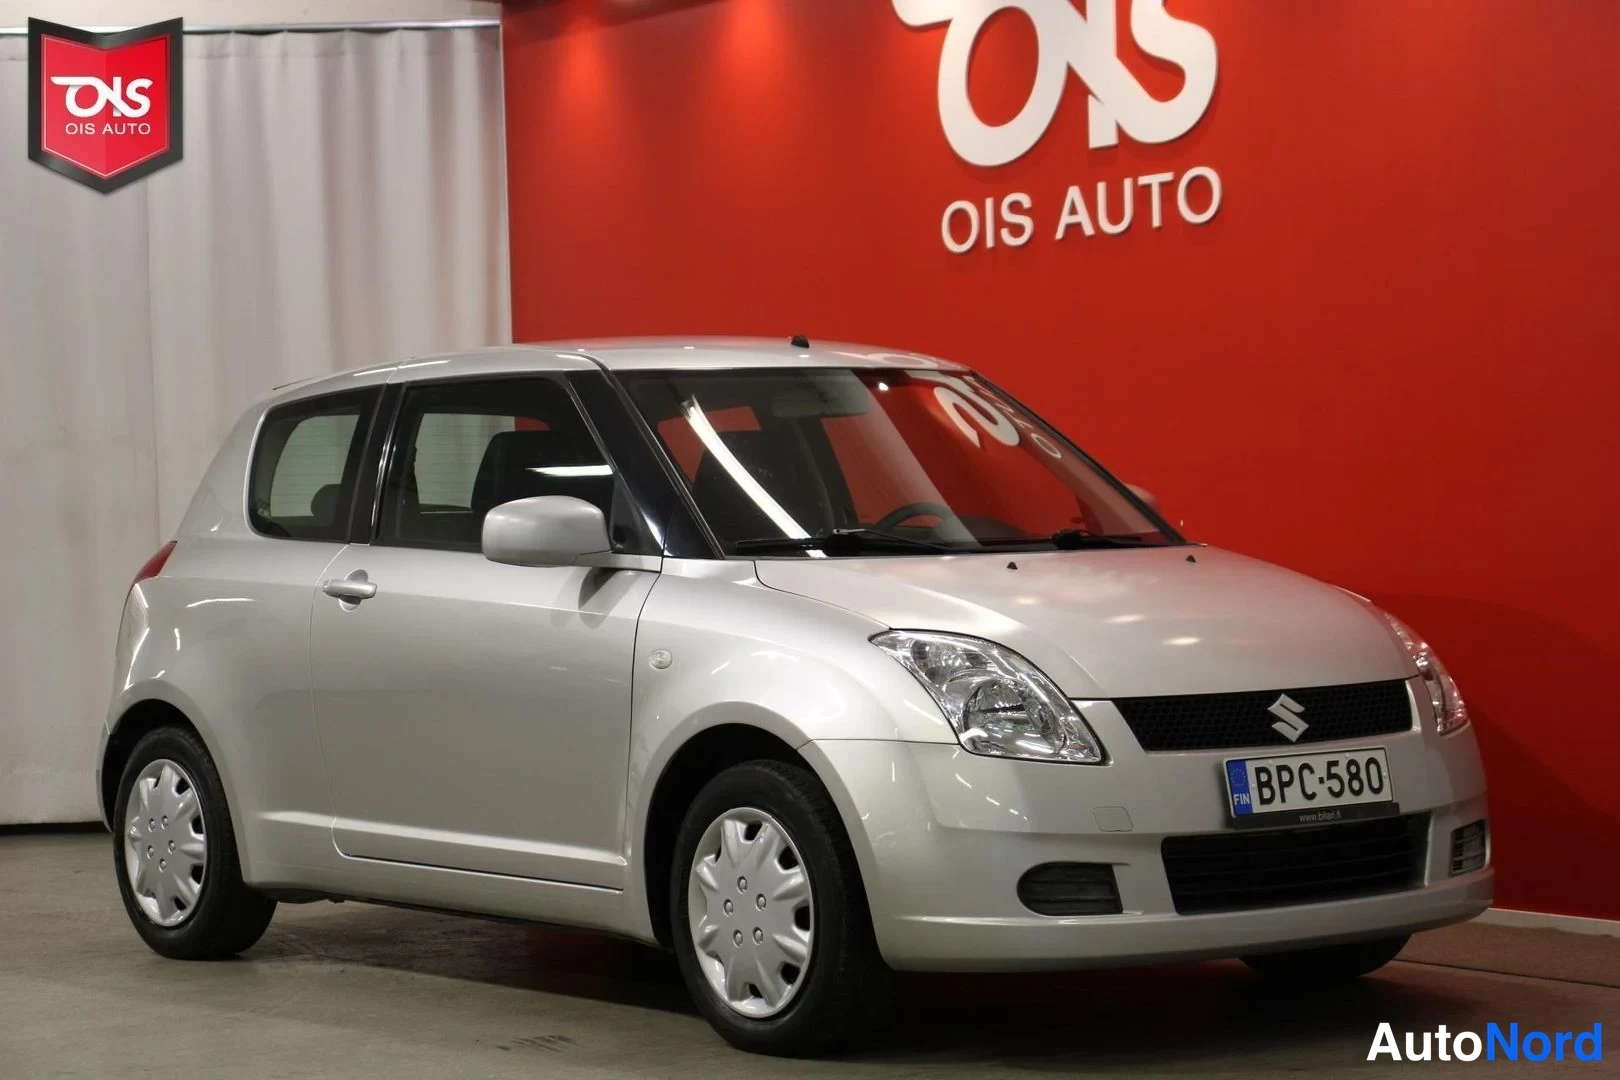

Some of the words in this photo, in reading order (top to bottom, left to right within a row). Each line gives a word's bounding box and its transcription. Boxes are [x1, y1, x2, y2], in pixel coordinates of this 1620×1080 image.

[941, 192, 1034, 254] OIS
[1055, 166, 1222, 240] AUTO
[1233, 792, 1250, 805] FIN
[1255, 757, 1384, 805] BPC-580
